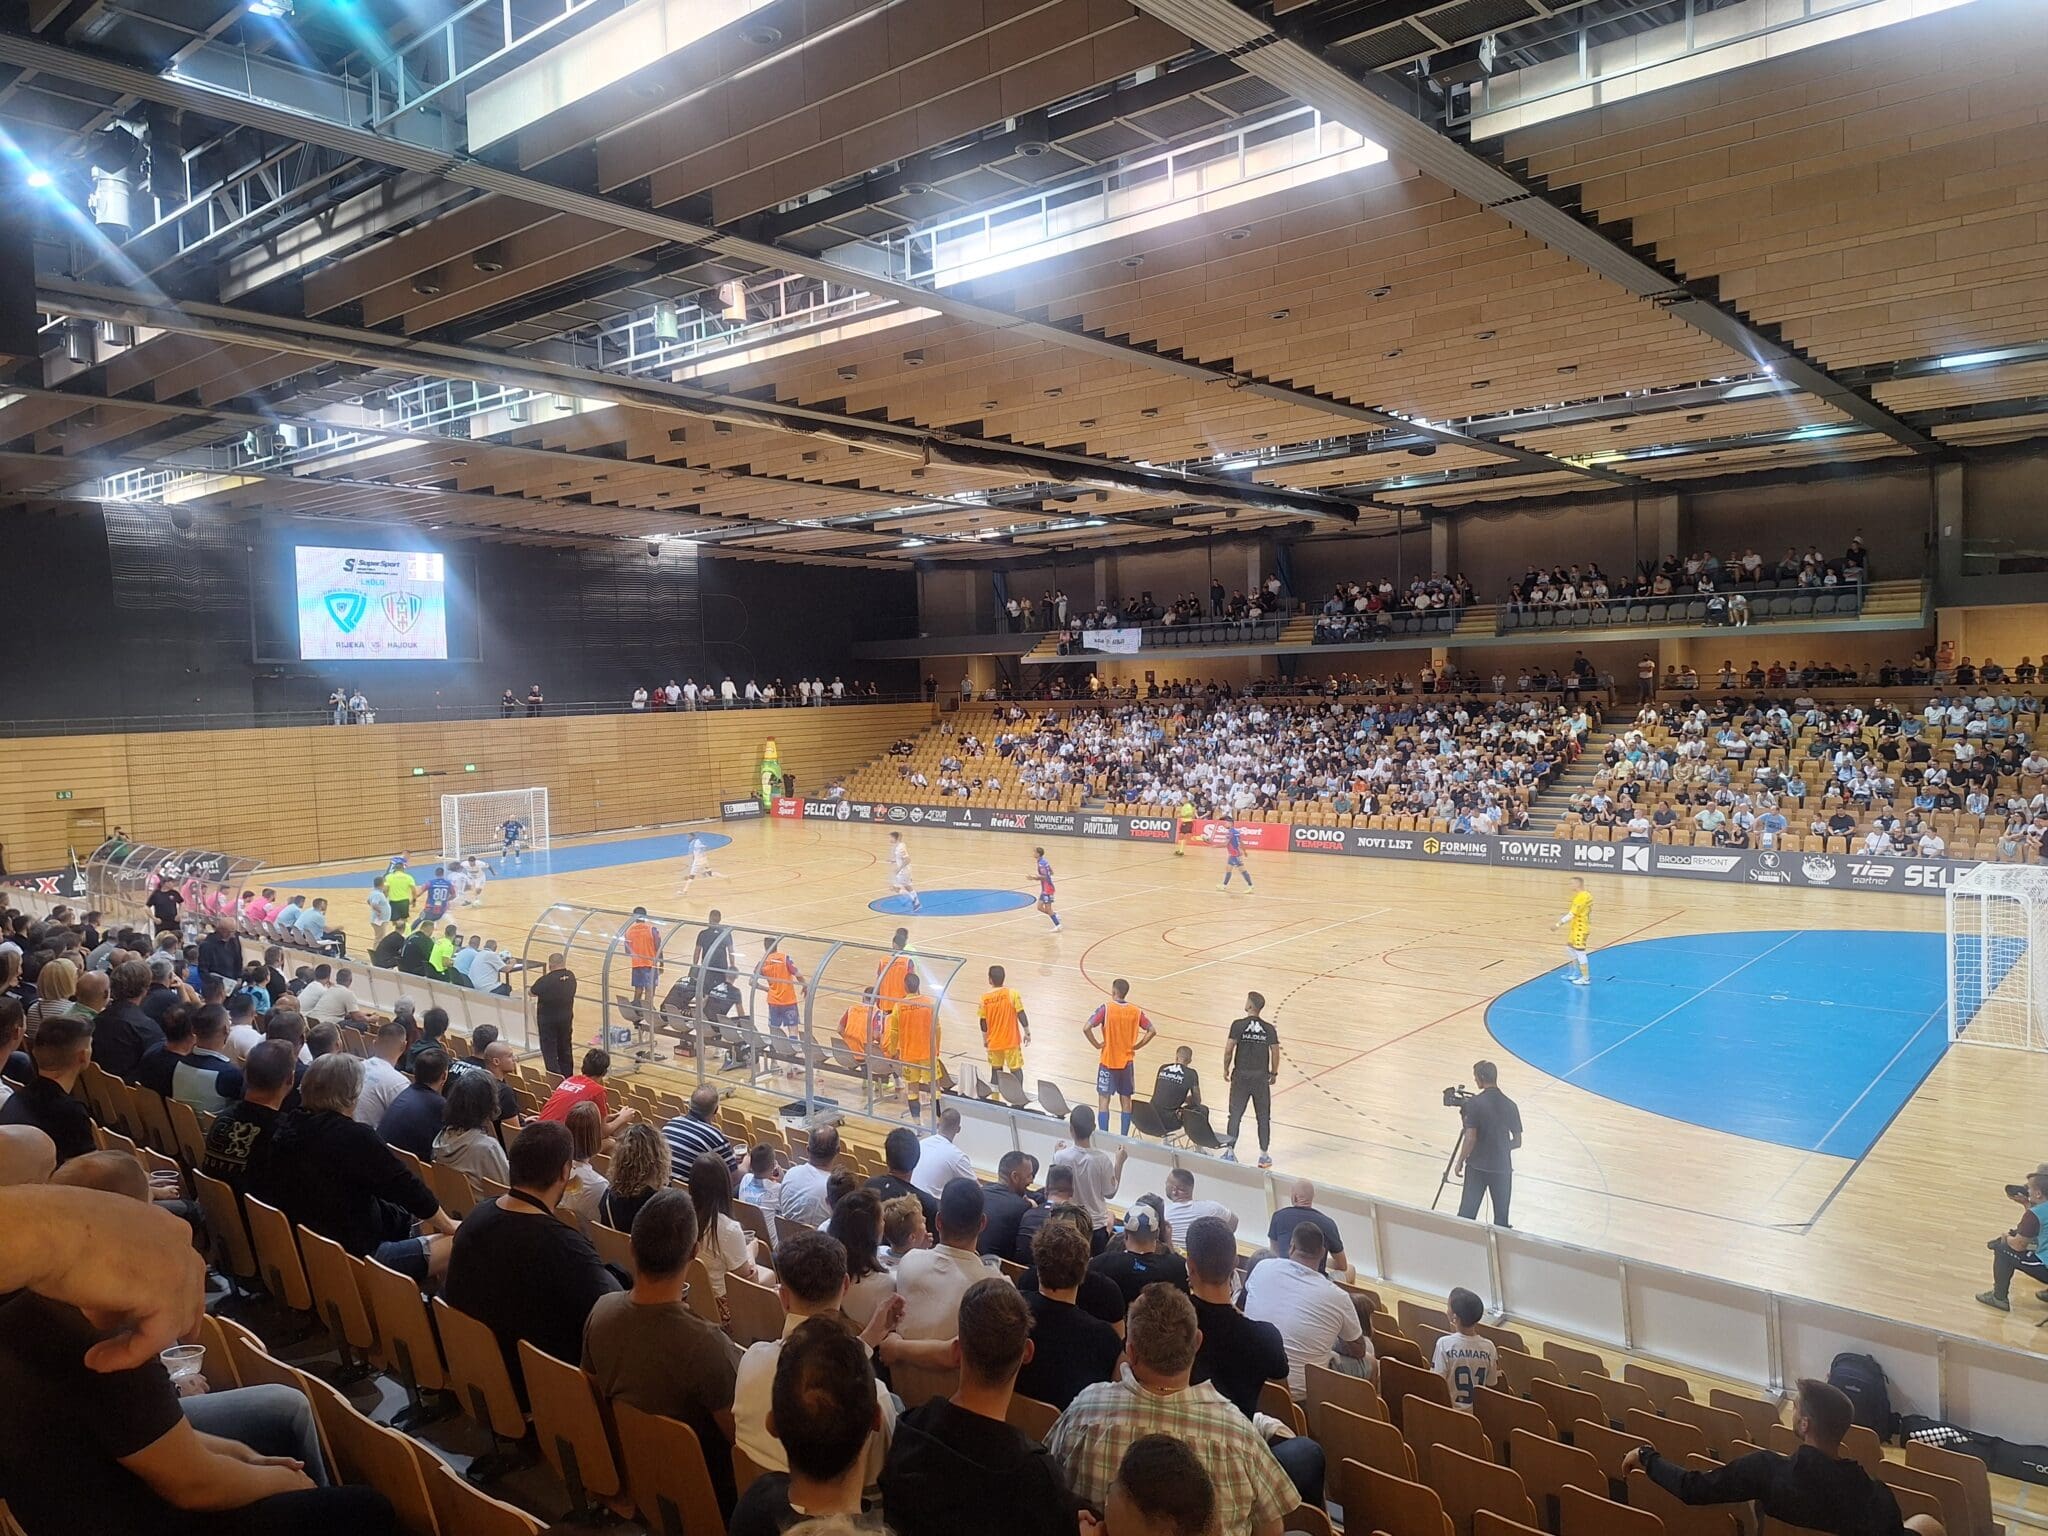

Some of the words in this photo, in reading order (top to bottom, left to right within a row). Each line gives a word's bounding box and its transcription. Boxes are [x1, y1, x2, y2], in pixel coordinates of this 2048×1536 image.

[778, 799, 796, 807] Super
[778, 807, 795, 816] Sport
[804, 802, 837, 817] SELECT
[991, 815, 1027, 829] RefleX
[1034, 814, 1075, 824] NOVINET.HR
[1130, 819, 1172, 831] COMO
[1034, 823, 1074, 831] TORPEDO.MEDIA
[1130, 829, 1169, 838] TEMPERA
[1295, 828, 1345, 842] COMO
[1295, 840, 1344, 850] TEMPERA
[1357, 837, 1385, 848] NOVI
[1388, 839, 1413, 850] LIST
[1440, 841, 1487, 853] FORMING
[1499, 841, 1562, 858] TOWER
[1574, 844, 1616, 862] HOP
[1852, 877, 1888, 885] partner
[432, 888, 448, 901] 80
[1455, 1365, 1486, 1405] 91
